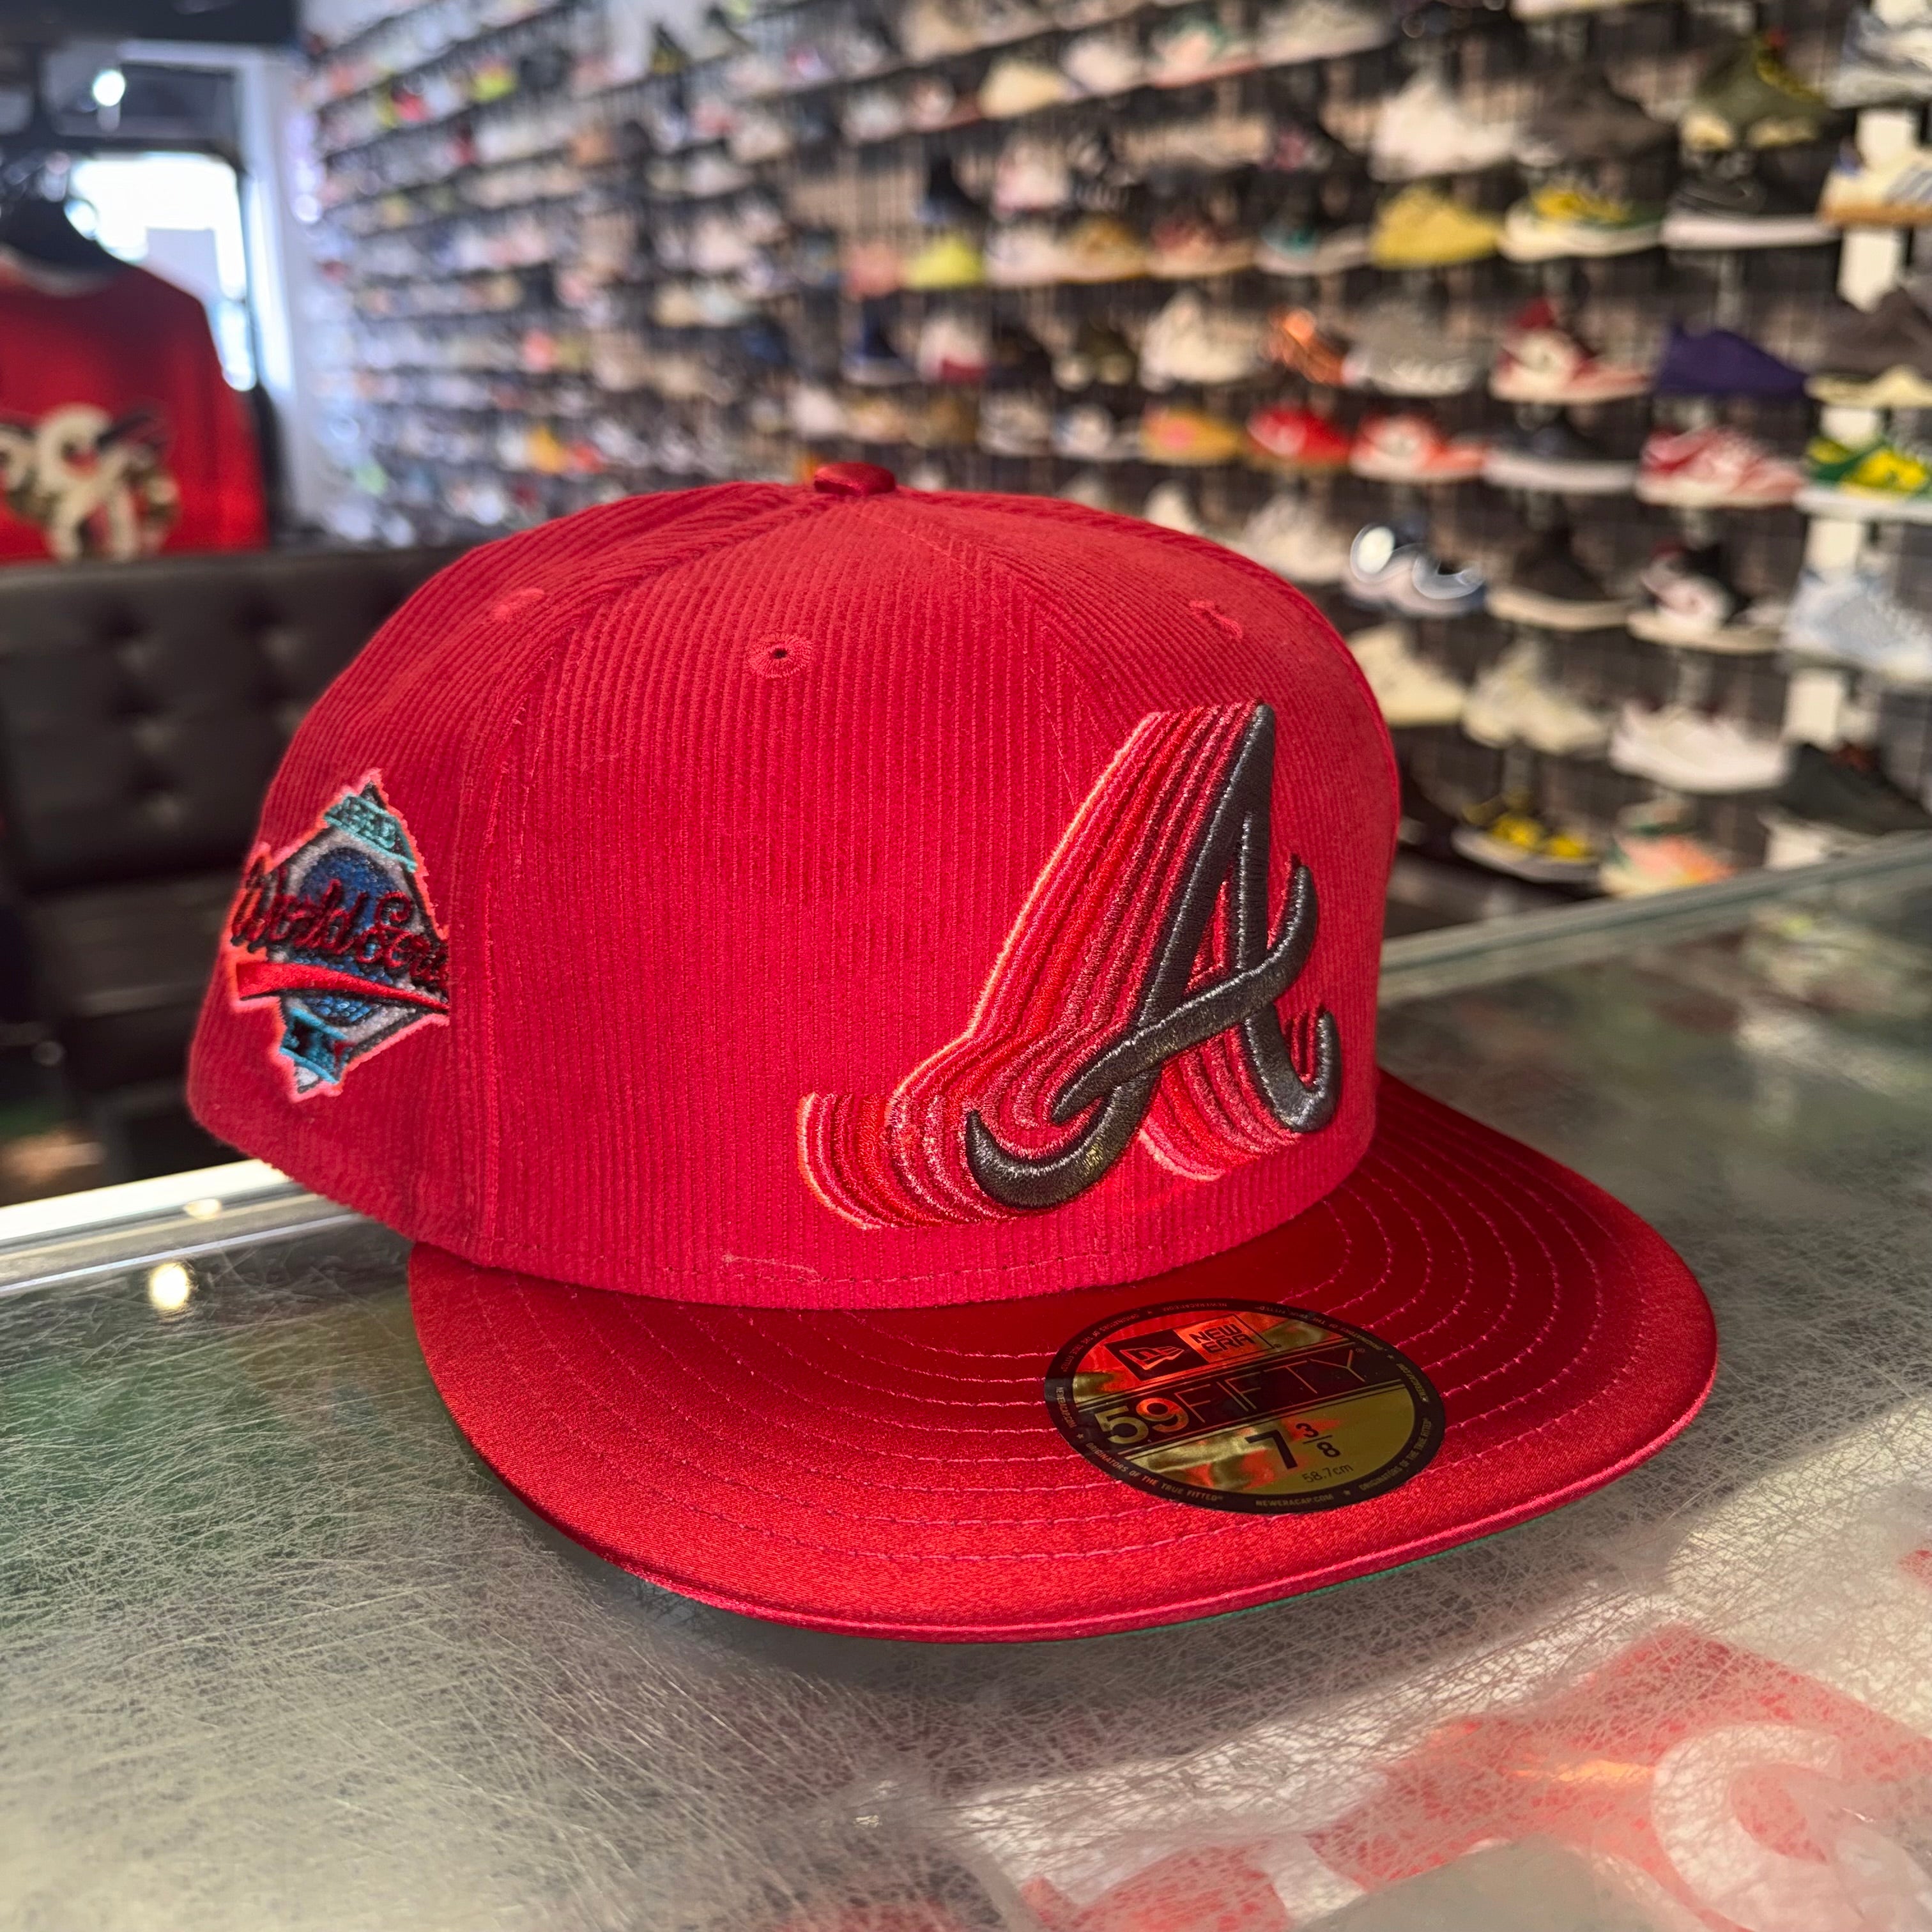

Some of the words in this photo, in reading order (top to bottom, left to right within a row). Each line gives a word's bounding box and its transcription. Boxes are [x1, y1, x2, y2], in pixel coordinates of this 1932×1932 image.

[1189, 1323, 1243, 1344] NEW
[1201, 1333, 1256, 1353] ERA
[1245, 1429, 1298, 1469] 7
[1085, 1441, 1130, 1473] ORIGINATORS
[1129, 1469, 1142, 1478] OF
[1141, 1475, 1160, 1487] THE
[1160, 1482, 1183, 1496] TRUE
[1301, 1463, 1354, 1484] 58.7cm
[1255, 1493, 1335, 1508] NEWERACAP.COM
